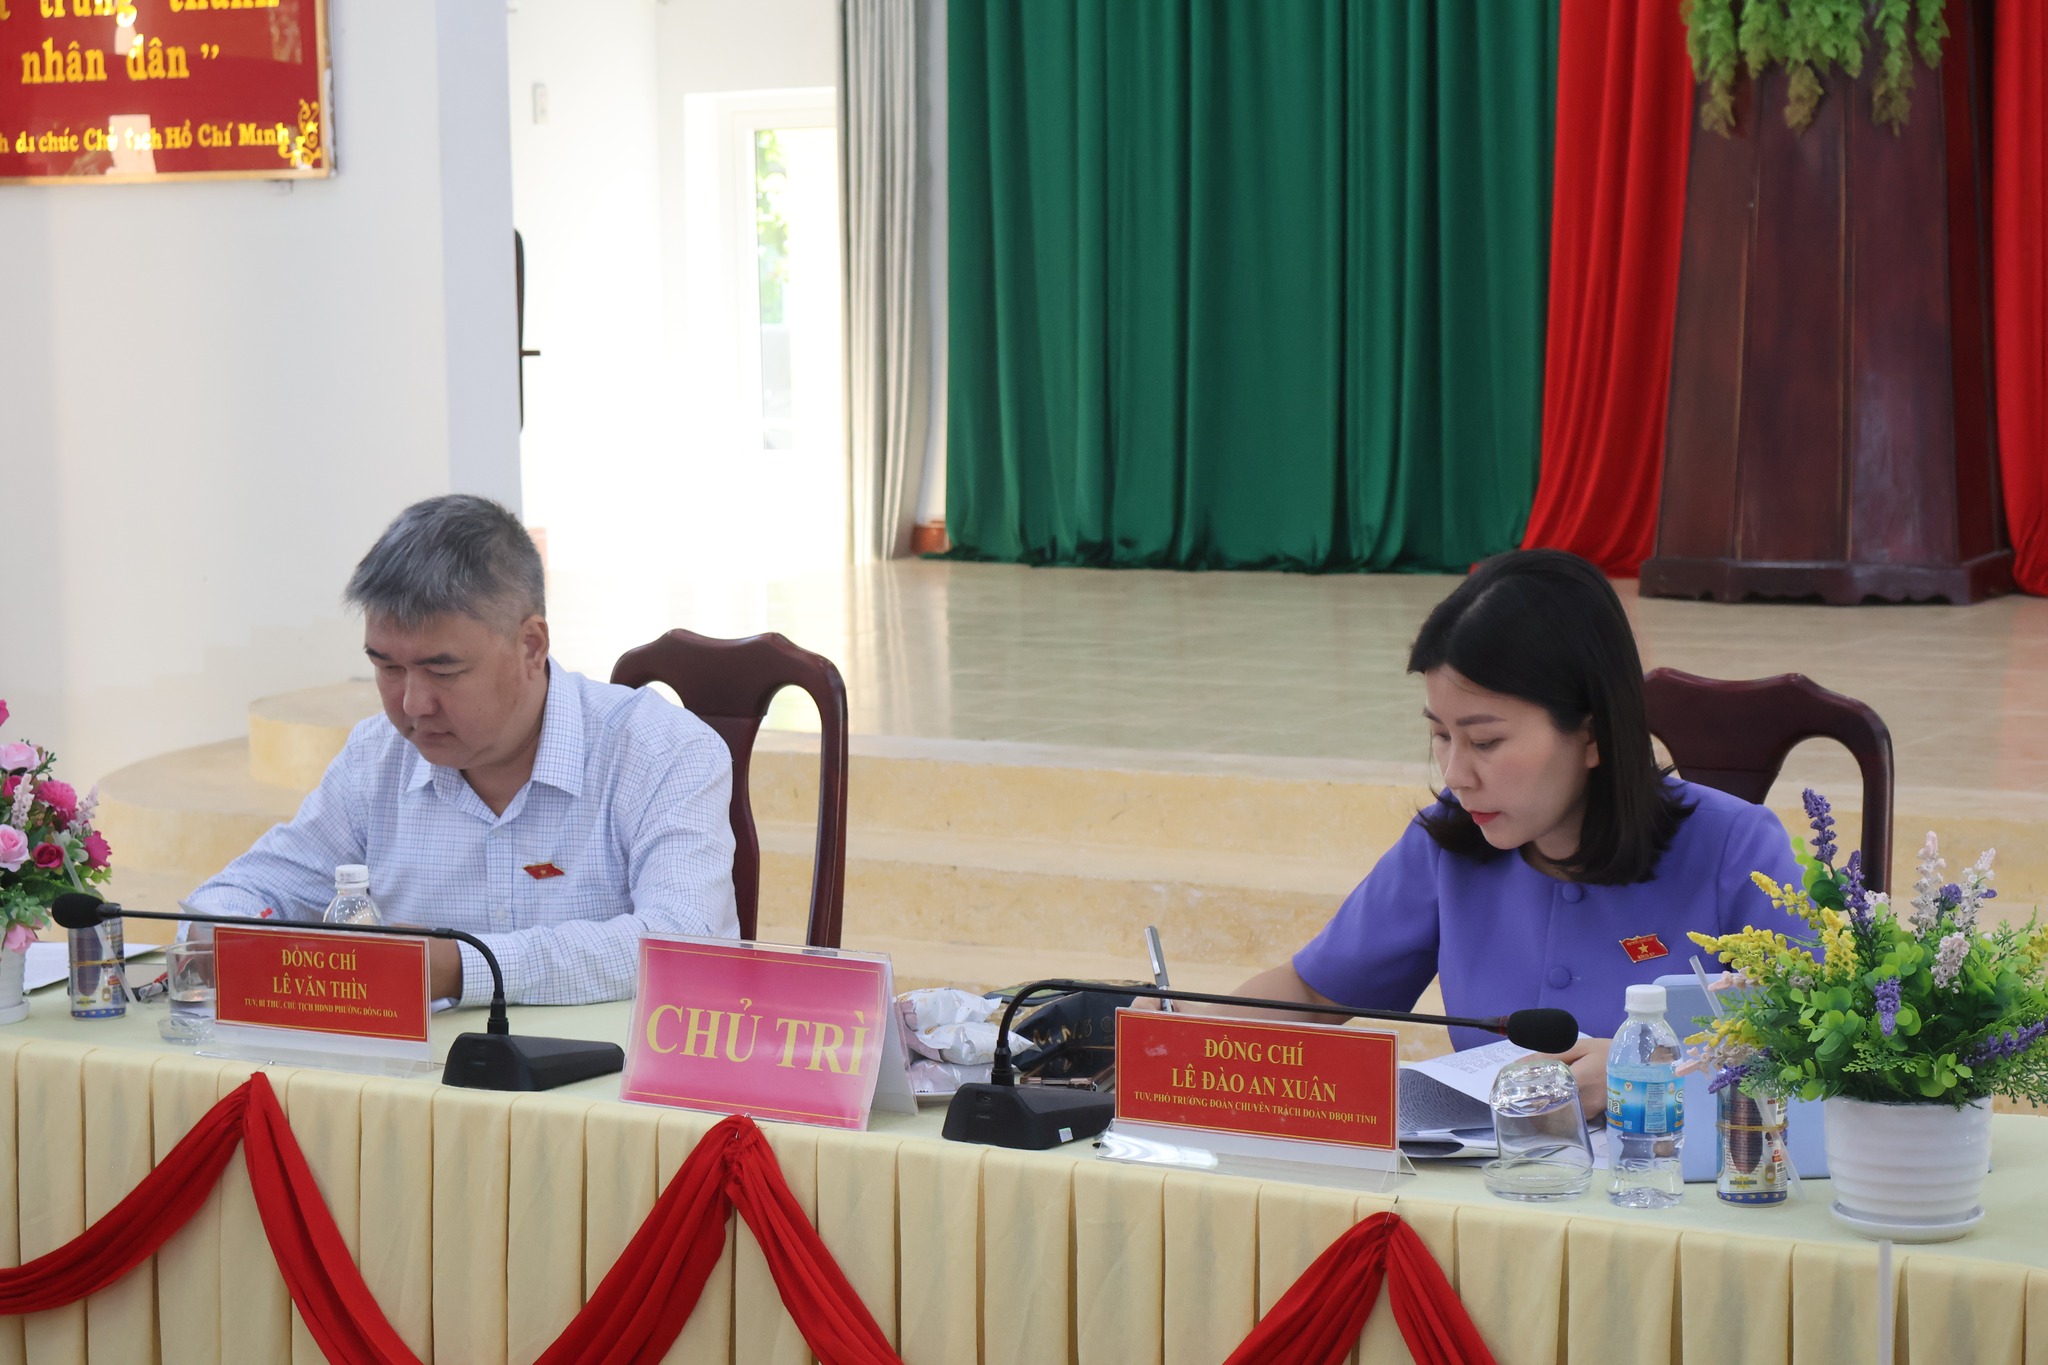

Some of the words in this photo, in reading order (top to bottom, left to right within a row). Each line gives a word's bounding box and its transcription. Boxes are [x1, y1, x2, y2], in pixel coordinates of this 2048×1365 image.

[21, 37, 107, 84] nhân
[126, 34, 190, 81] dân
[38, 127, 80, 153] chúc
[165, 119, 192, 148] Hồ
[198, 122, 233, 148] Chí
[238, 122, 290, 147] Minh
[281, 945, 325, 969] ĐỒNG
[328, 949, 357, 971] CHÍ
[272, 972, 292, 995] LÊ
[294, 975, 326, 998] VĂN
[329, 977, 368, 1000] THÌN
[646, 997, 763, 1063] CHỦ
[775, 1010, 870, 1077] TRÌ
[1204, 1034, 1263, 1063] ĐỒNG
[1267, 1041, 1304, 1066] CHÍ
[1172, 1063, 1197, 1089] LÊ
[1202, 1067, 1245, 1094] ĐÀO
[1248, 1075, 1276, 1096] AN
[1281, 1075, 1337, 1102] XUÂN
[1153, 1092, 1171, 1103] PHÓ
[1209, 1098, 1234, 1109] ĐOÀN
[1235, 1101, 1270, 1113] CHUYÊN
[1272, 1104, 1301, 1117] TRÁCH
[1303, 1108, 1327, 1119] ĐOÀN
[1329, 1111, 1354, 1123] ĐBQH
[1355, 1112, 1377, 1125] TỈNH
